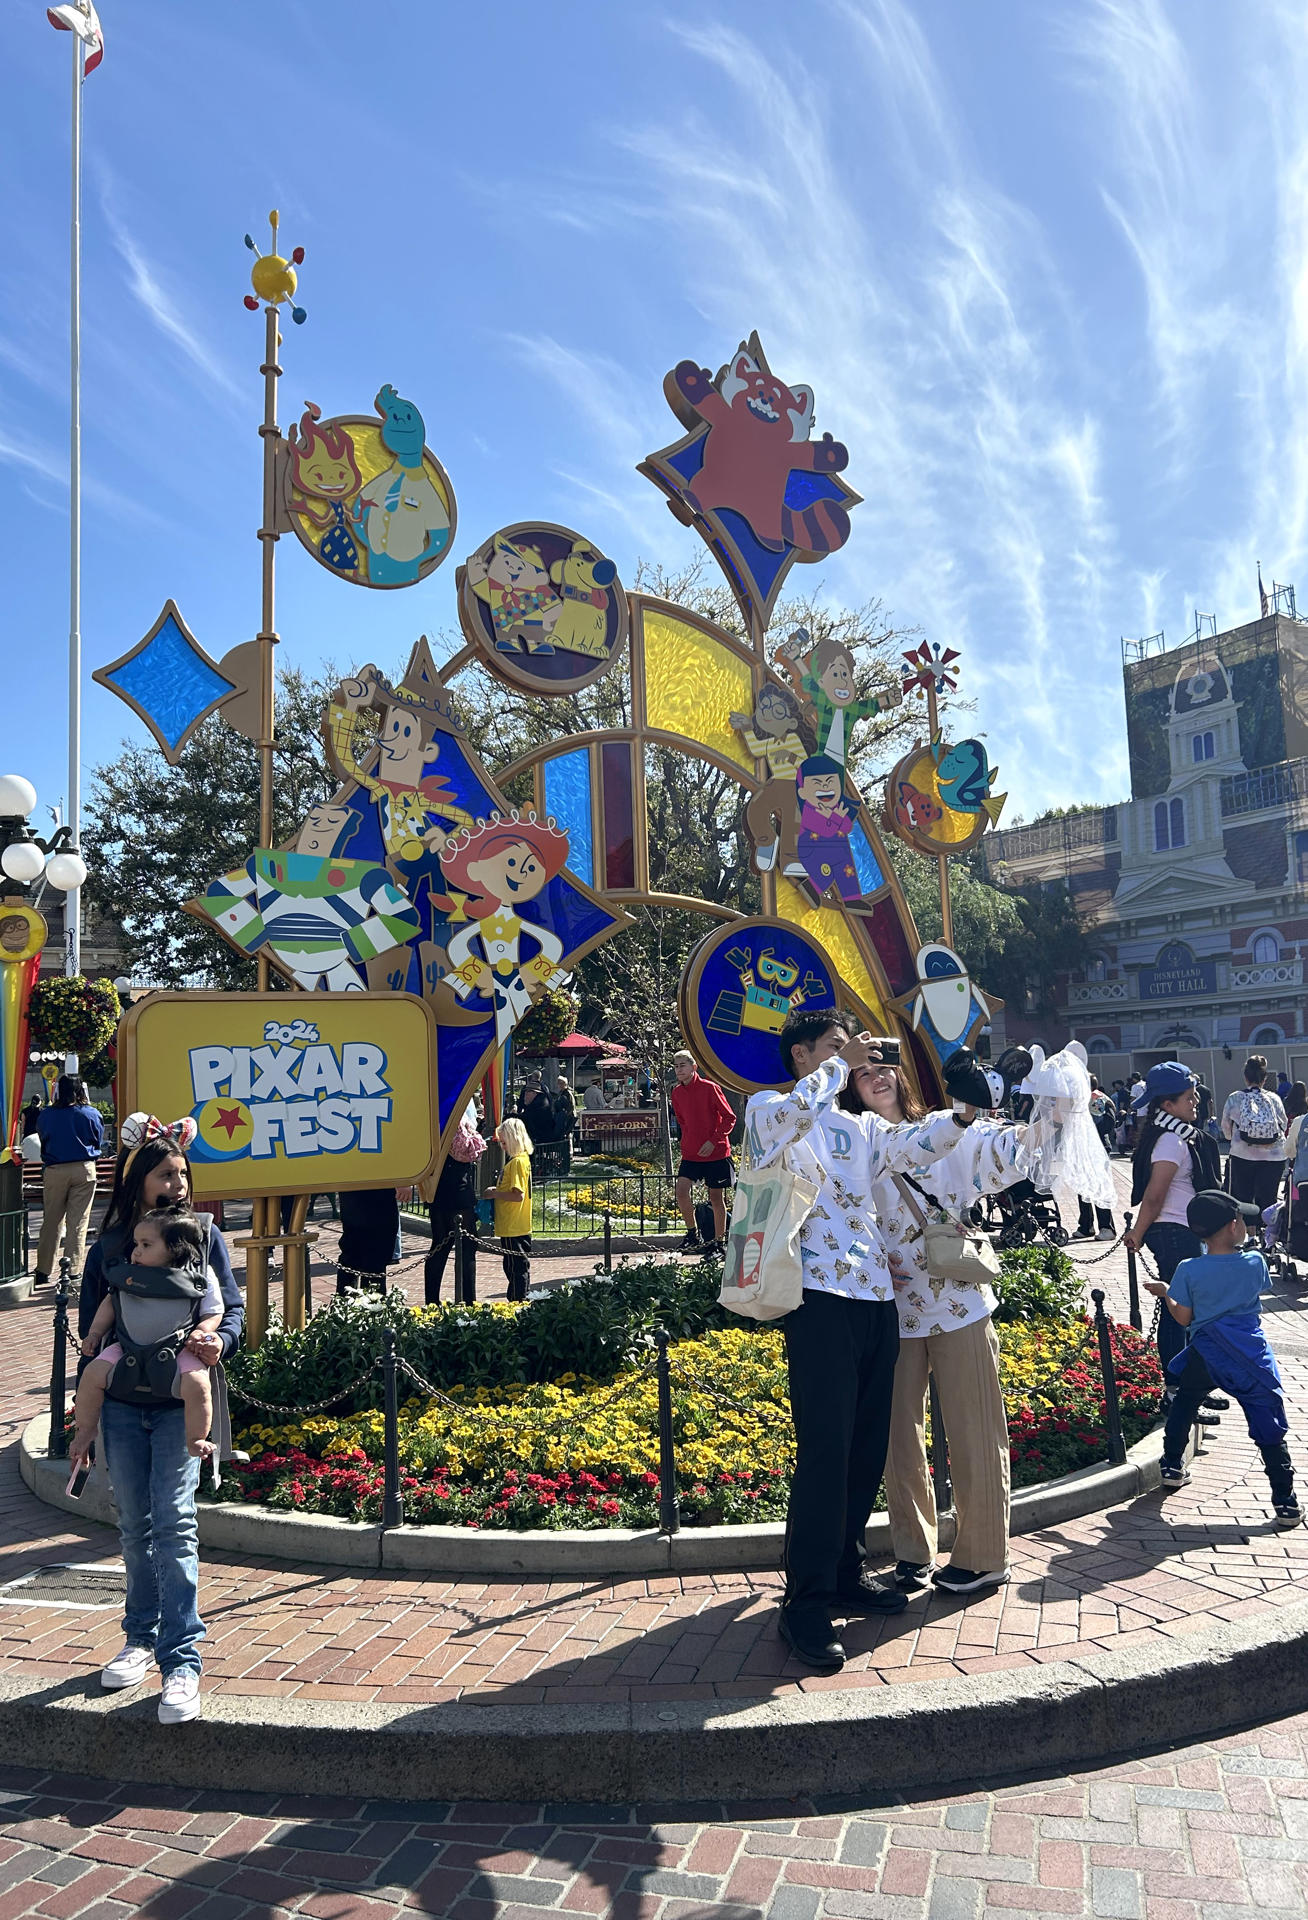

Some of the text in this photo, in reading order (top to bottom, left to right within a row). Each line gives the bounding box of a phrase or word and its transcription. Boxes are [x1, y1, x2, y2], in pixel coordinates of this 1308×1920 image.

[1150, 978, 1208, 994] CITY HALL
[1153, 968, 1201, 981] DISNEYLAND
[264, 1019, 320, 1046] 2024
[189, 1042, 391, 1102] PIXAR
[249, 1097, 392, 1160] FEST
